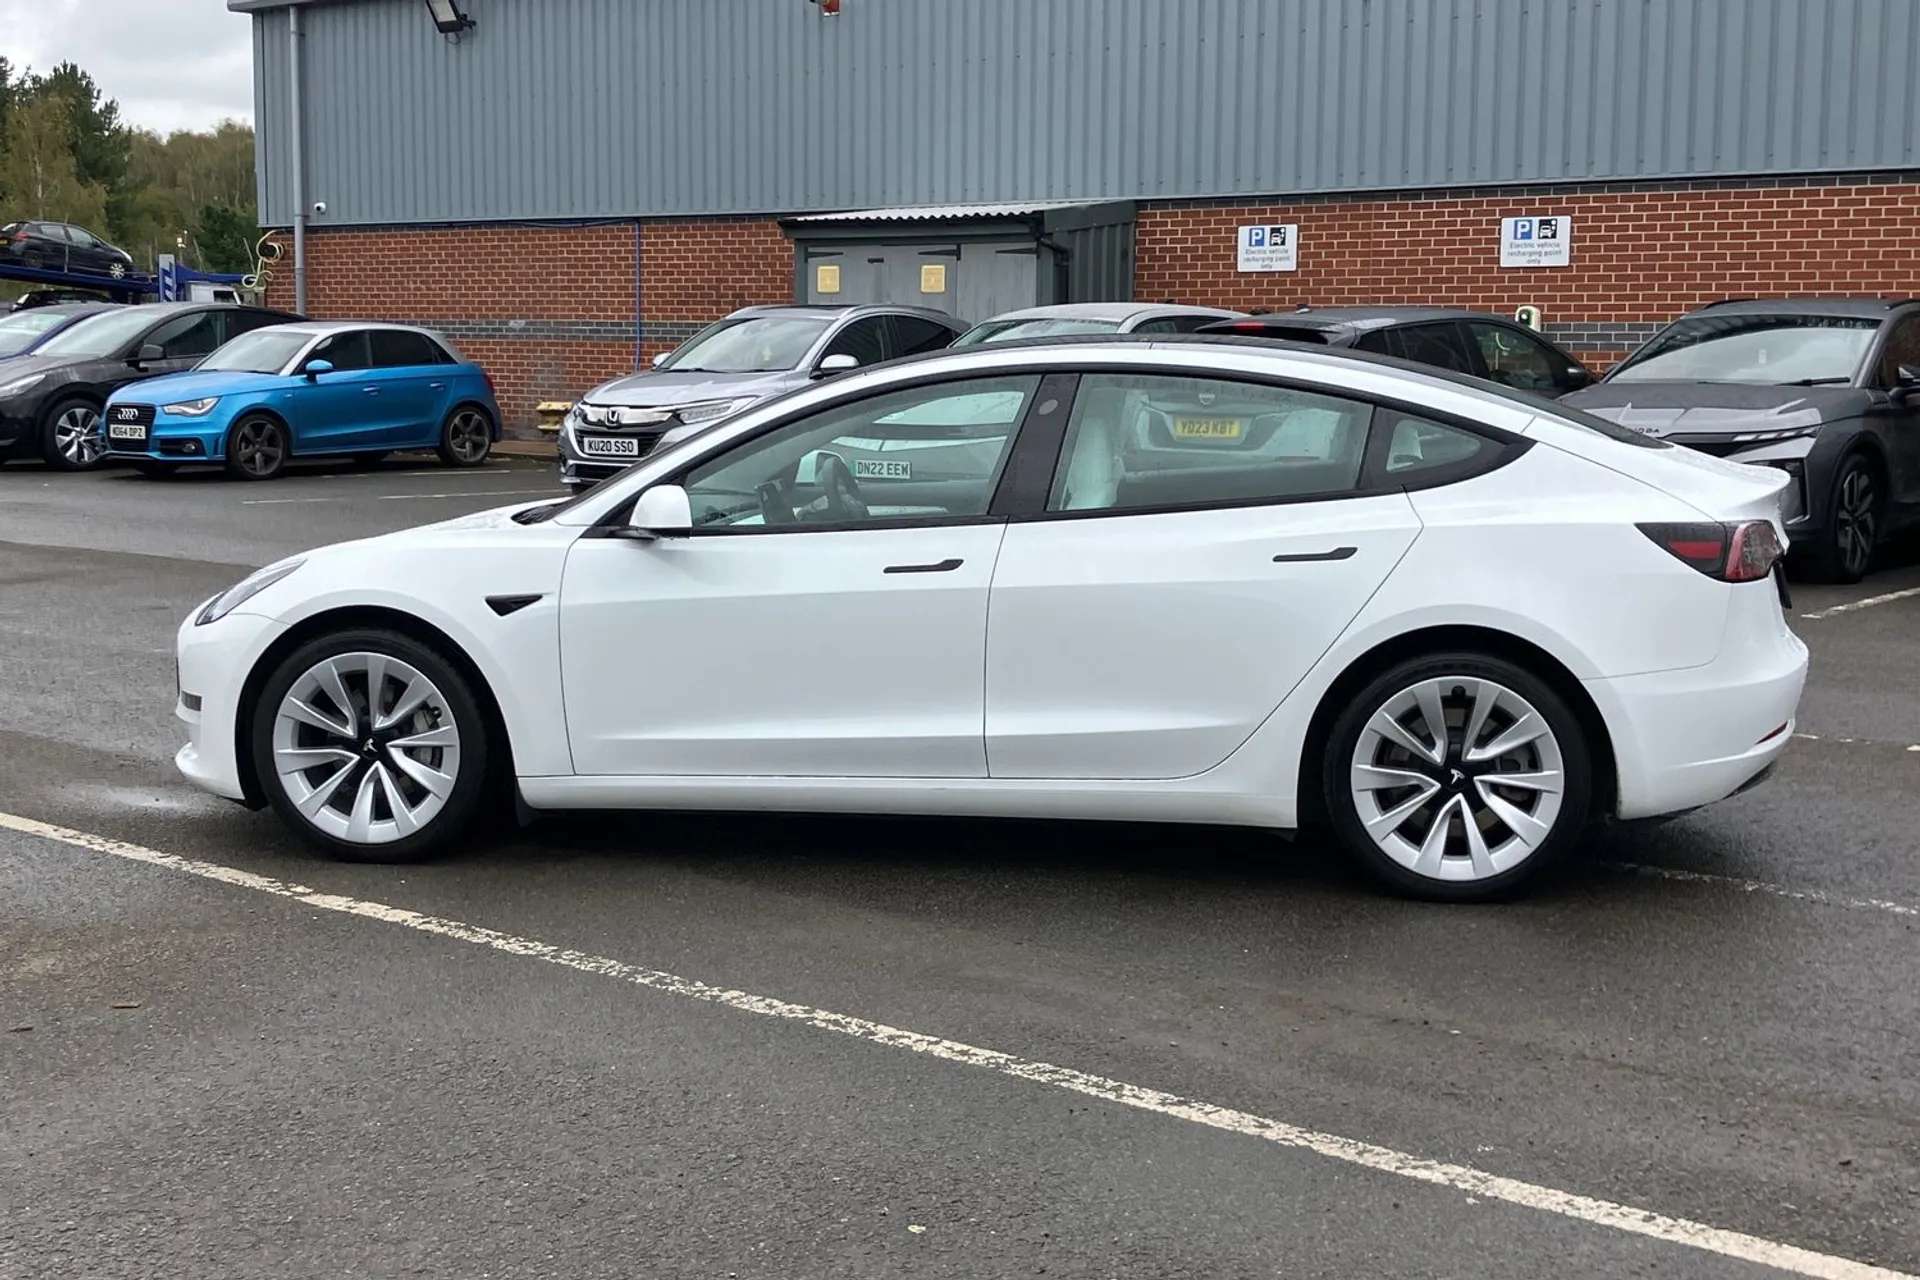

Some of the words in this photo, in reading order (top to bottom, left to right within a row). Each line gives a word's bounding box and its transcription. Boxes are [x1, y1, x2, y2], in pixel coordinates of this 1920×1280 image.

[1251, 228, 1263, 246] P
[1517, 221, 1530, 239] P
[588, 440, 612, 451] KU20
[857, 462, 884, 474] DN22
